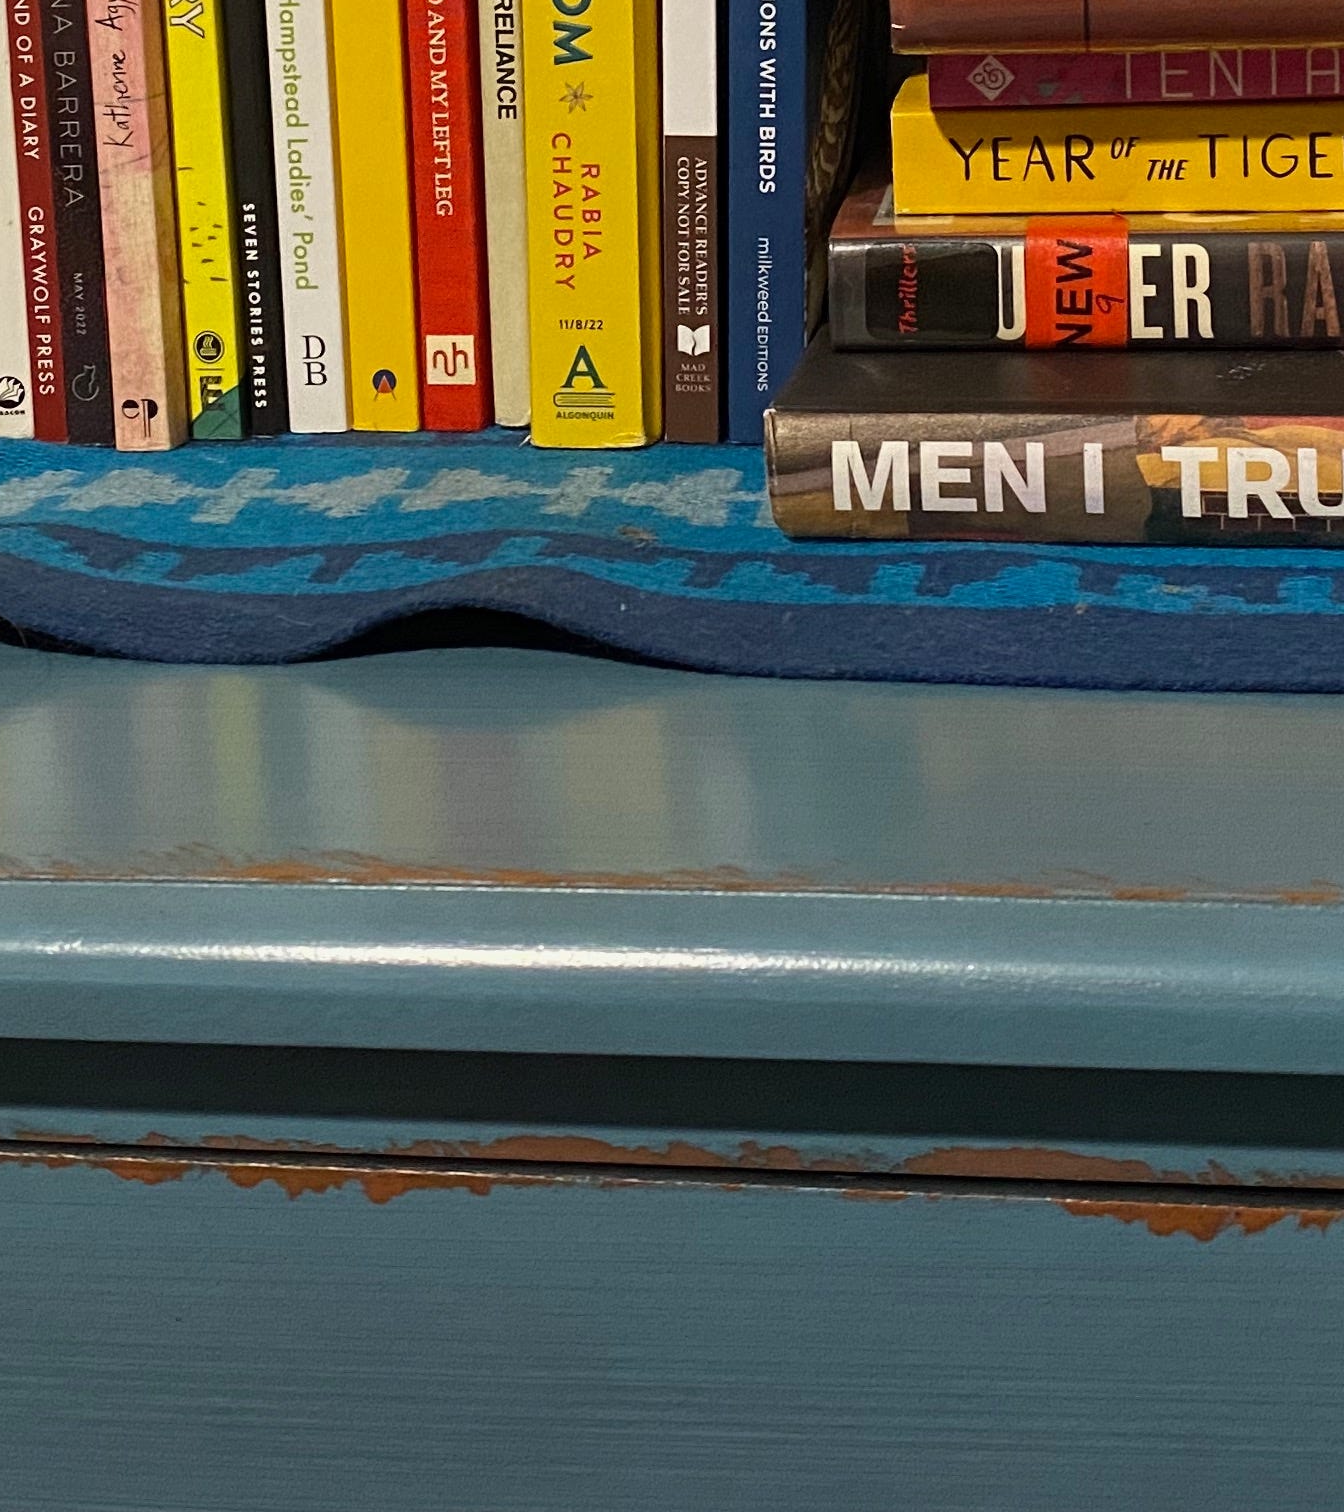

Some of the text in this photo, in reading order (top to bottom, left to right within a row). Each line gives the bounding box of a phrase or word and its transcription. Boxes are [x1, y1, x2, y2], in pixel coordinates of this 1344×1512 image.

[758, 57, 777, 119] WITH
[757, 126, 777, 194] BIRDS
[948, 132, 1097, 182] YEAR
[1110, 136, 1140, 159] OF
[1146, 157, 1188, 181] THE
[551, 133, 576, 291] CHAUDRY
[580, 163, 602, 262] RABIA
[677, 156, 690, 316] COPY NOT FOR SALE
[694, 156, 709, 317] ADVANCE READER'S
[558, 318, 604, 331] 11/8/22
[831, 441, 1047, 513] MEN
[1083, 441, 1105, 515] I
